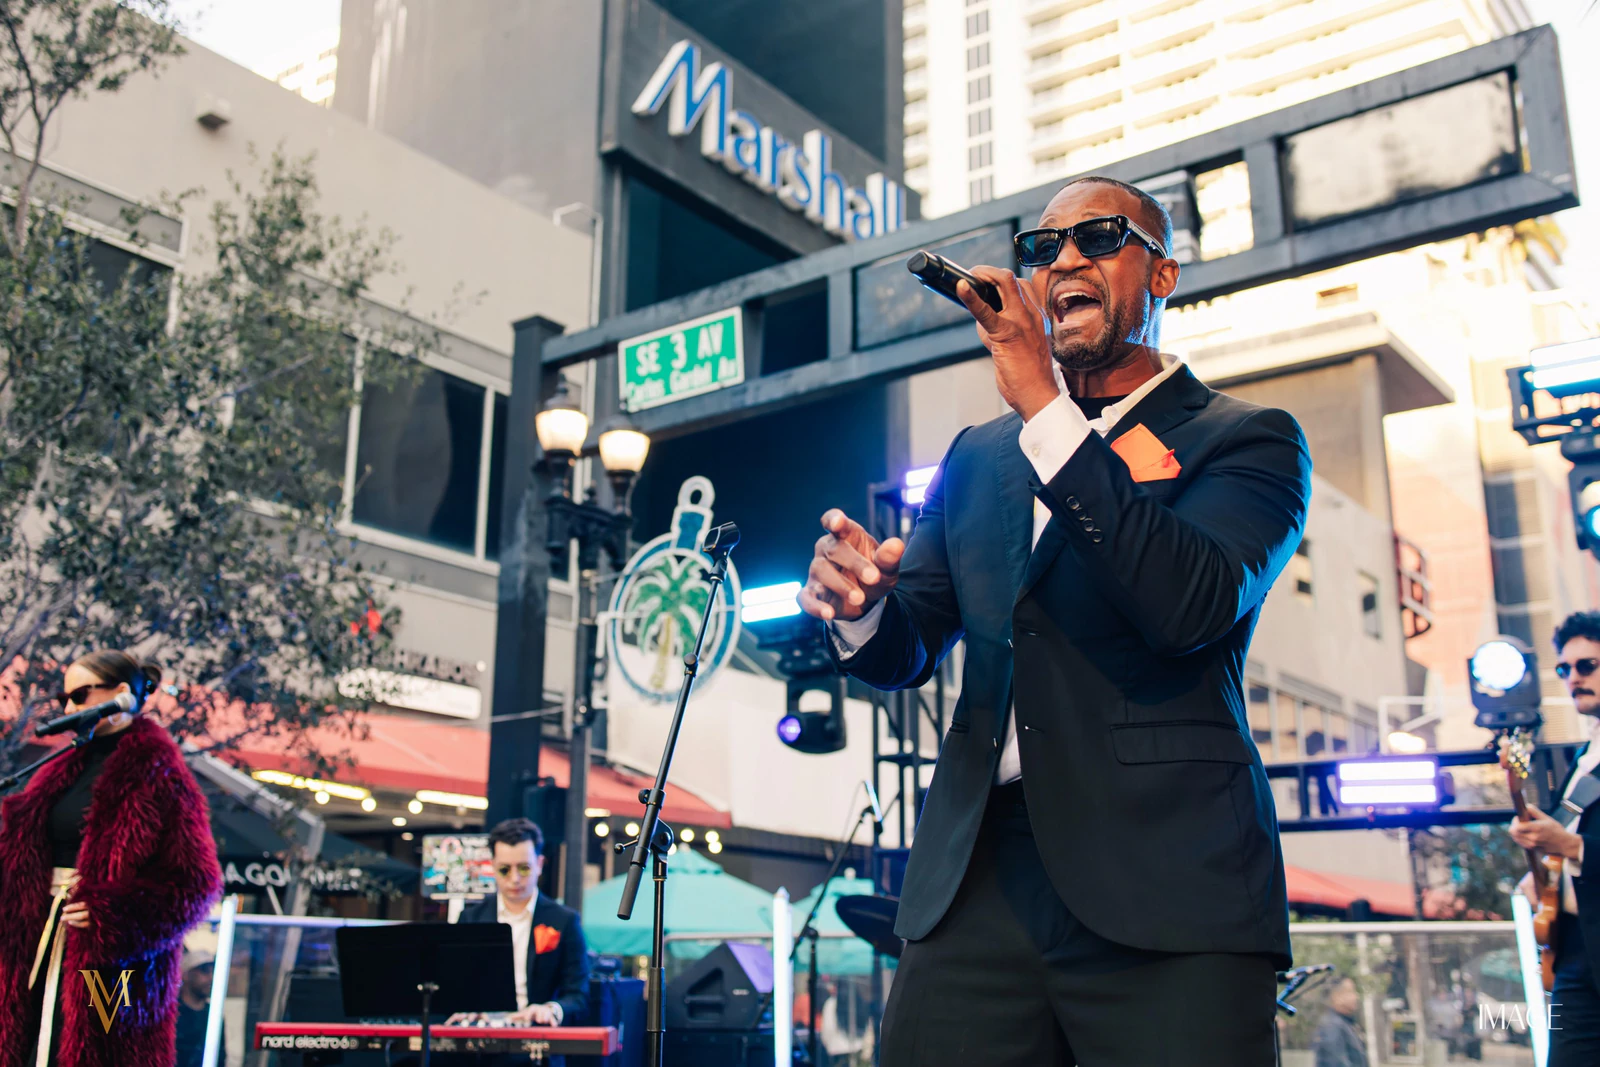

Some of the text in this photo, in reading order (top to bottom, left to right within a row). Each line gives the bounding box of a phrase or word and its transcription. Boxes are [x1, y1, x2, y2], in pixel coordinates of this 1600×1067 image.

[631, 39, 905, 240] Marshall
[636, 322, 723, 376] SE 3 AV
[262, 1035, 295, 1048] nord
